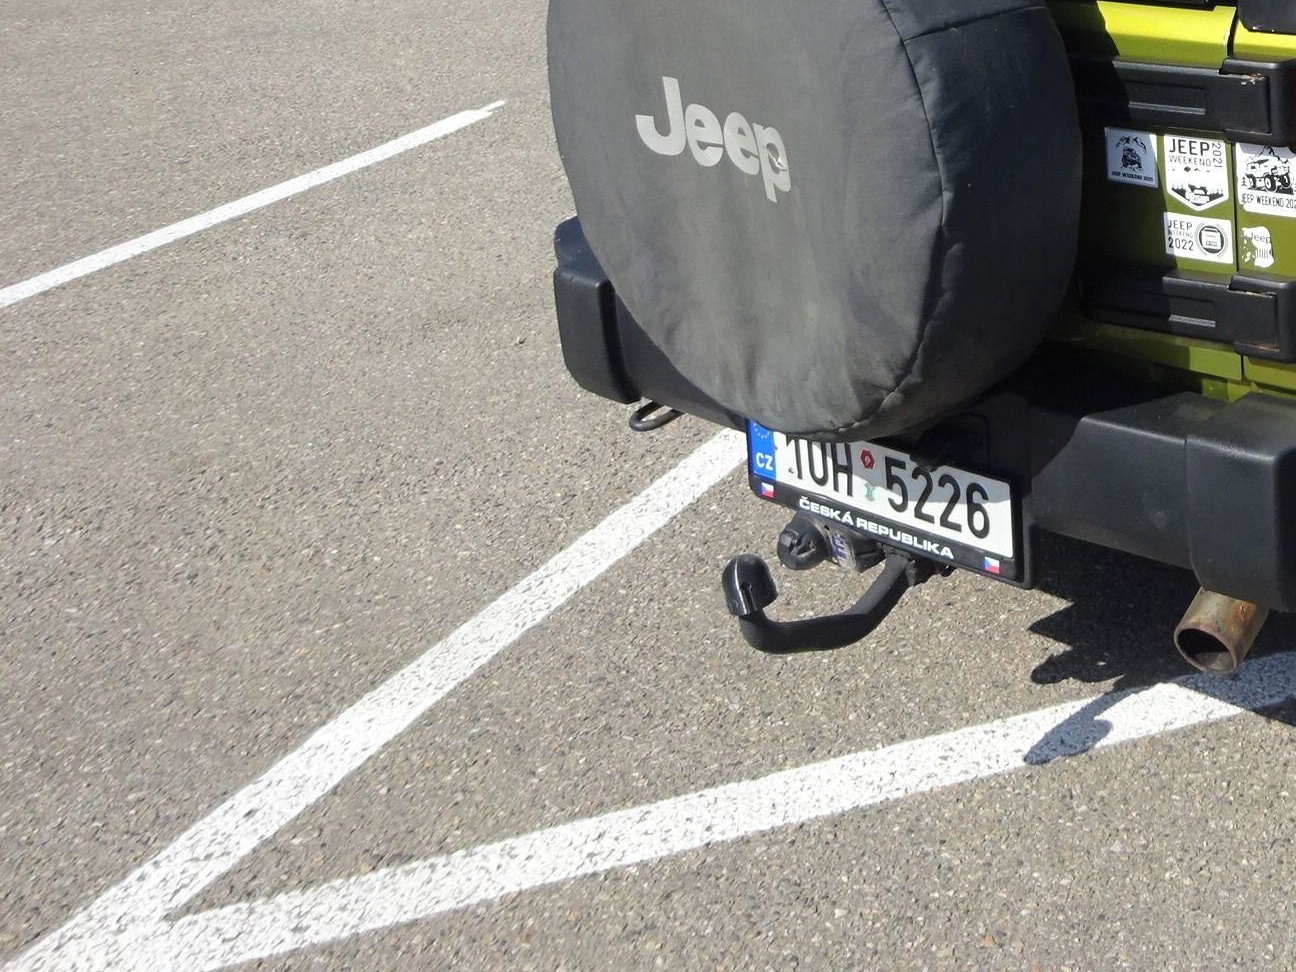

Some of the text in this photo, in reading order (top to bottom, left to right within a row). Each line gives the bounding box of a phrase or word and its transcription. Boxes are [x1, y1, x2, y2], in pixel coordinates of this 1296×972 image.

[635, 75, 792, 203] Jeep
[1168, 138, 1210, 155] JEEP
[1168, 154, 1212, 167] WEEKEND
[1212, 142, 1223, 168] 2021
[1241, 193, 1255, 204] JEEP
[1255, 195, 1284, 207] WEEKEND
[1167, 219, 1193, 230] JEEP
[1168, 237, 1195, 251] 2022
[1251, 232, 1272, 244] Jeep
[756, 451, 774, 471] CZ
[786, 437, 991, 539] 1UH 5226
[799, 495, 854, 524] ČESKÁ
[855, 517, 955, 560] REPUBLIKA
